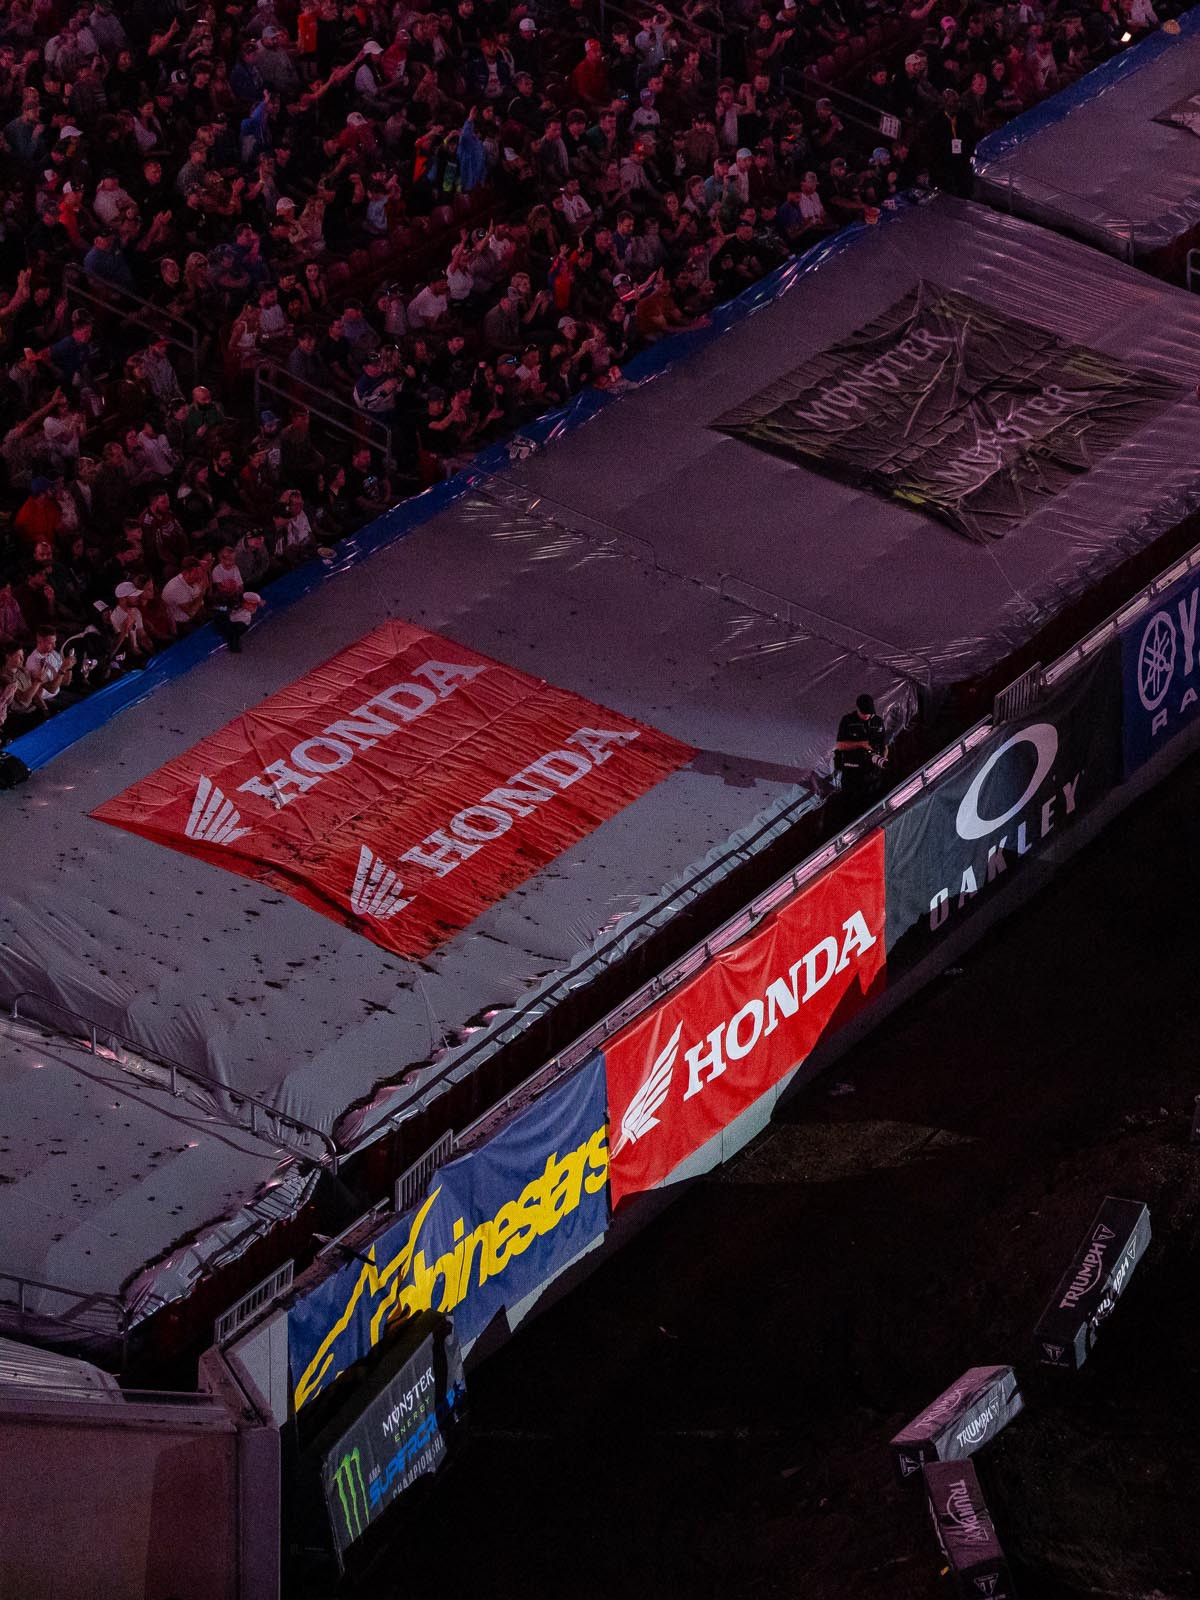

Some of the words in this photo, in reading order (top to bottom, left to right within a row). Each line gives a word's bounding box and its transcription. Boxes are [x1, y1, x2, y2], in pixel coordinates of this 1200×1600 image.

[793, 327, 945, 430] MONSTER
[235, 657, 488, 810] HONDA
[398, 722, 640, 878] HONDA
[928, 773, 1082, 933] OAKLEY
[682, 908, 877, 1101] HONDA
[1058, 1241, 1108, 1310] TRIUMPH
[382, 1366, 436, 1438] MONSTER
[393, 1396, 431, 1443] ENERGY
[956, 1410, 994, 1448] TRIUMPH
